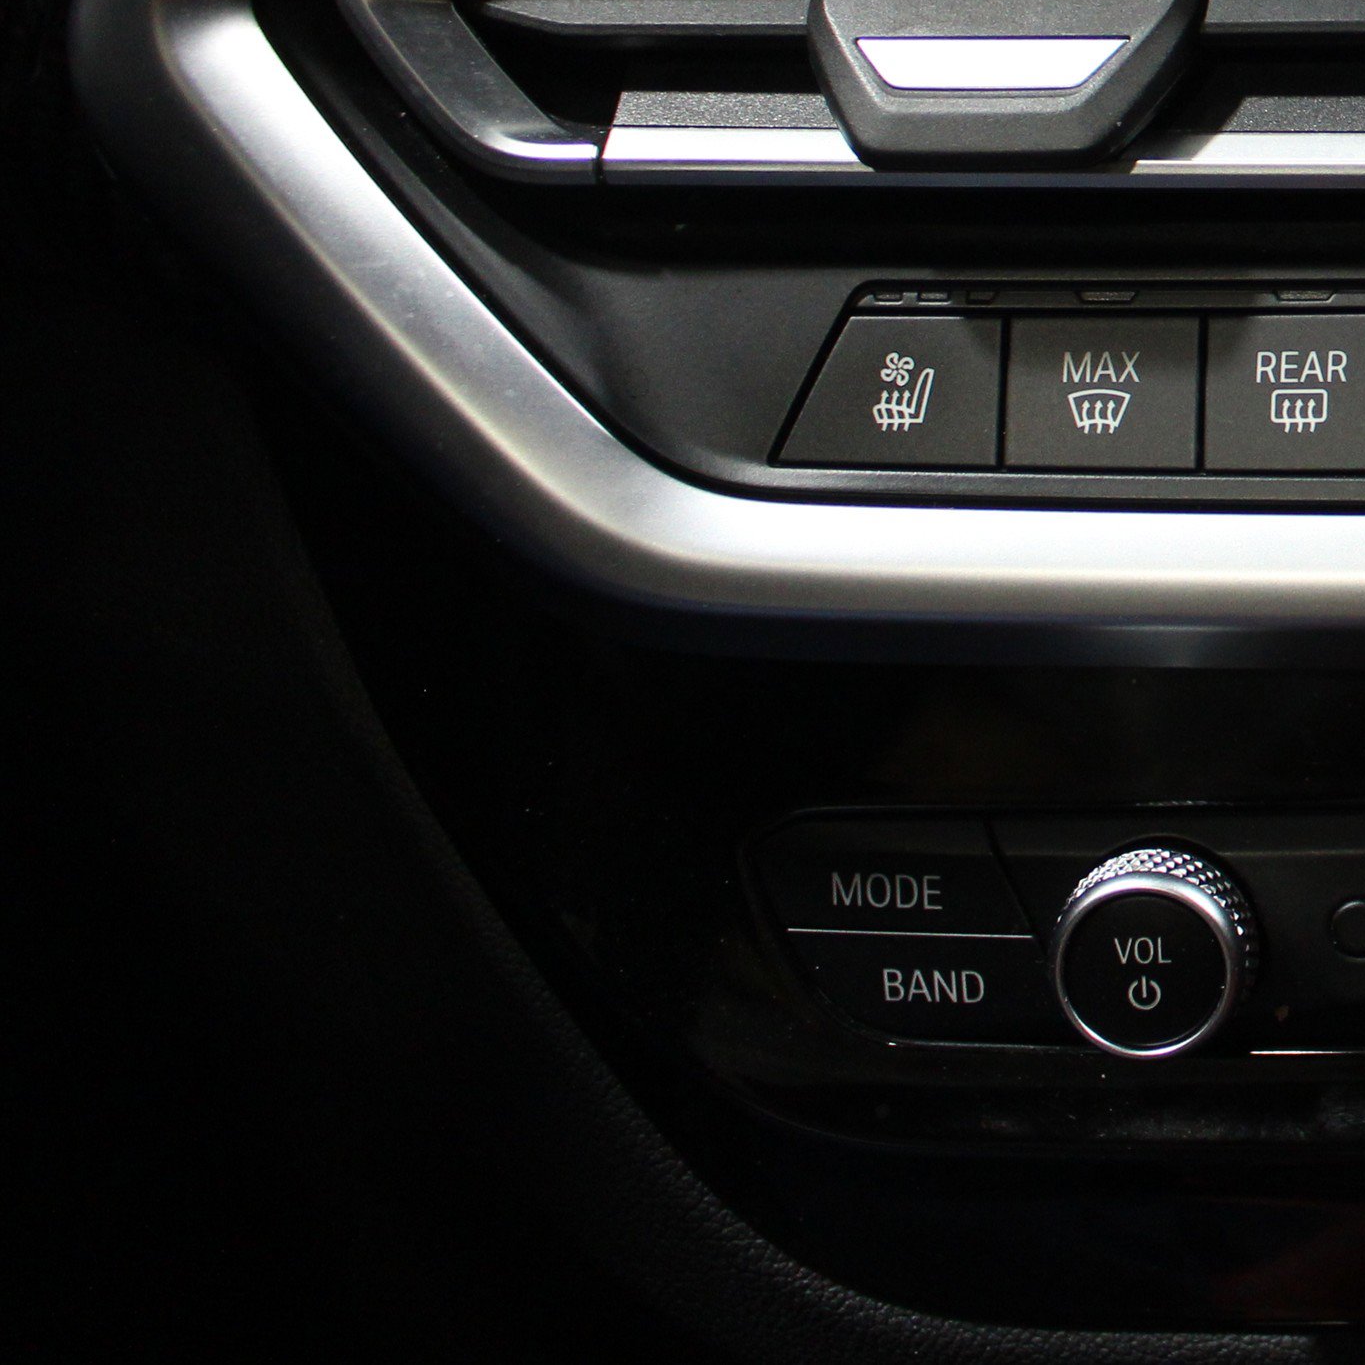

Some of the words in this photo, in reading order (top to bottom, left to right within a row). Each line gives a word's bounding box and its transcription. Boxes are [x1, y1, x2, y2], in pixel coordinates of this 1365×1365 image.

[1062, 352, 1140, 384] MAX
[1255, 350, 1348, 384] REAR
[832, 872, 943, 910] MODE
[1113, 936, 1172, 965] VOL
[882, 968, 985, 1004] BAND
